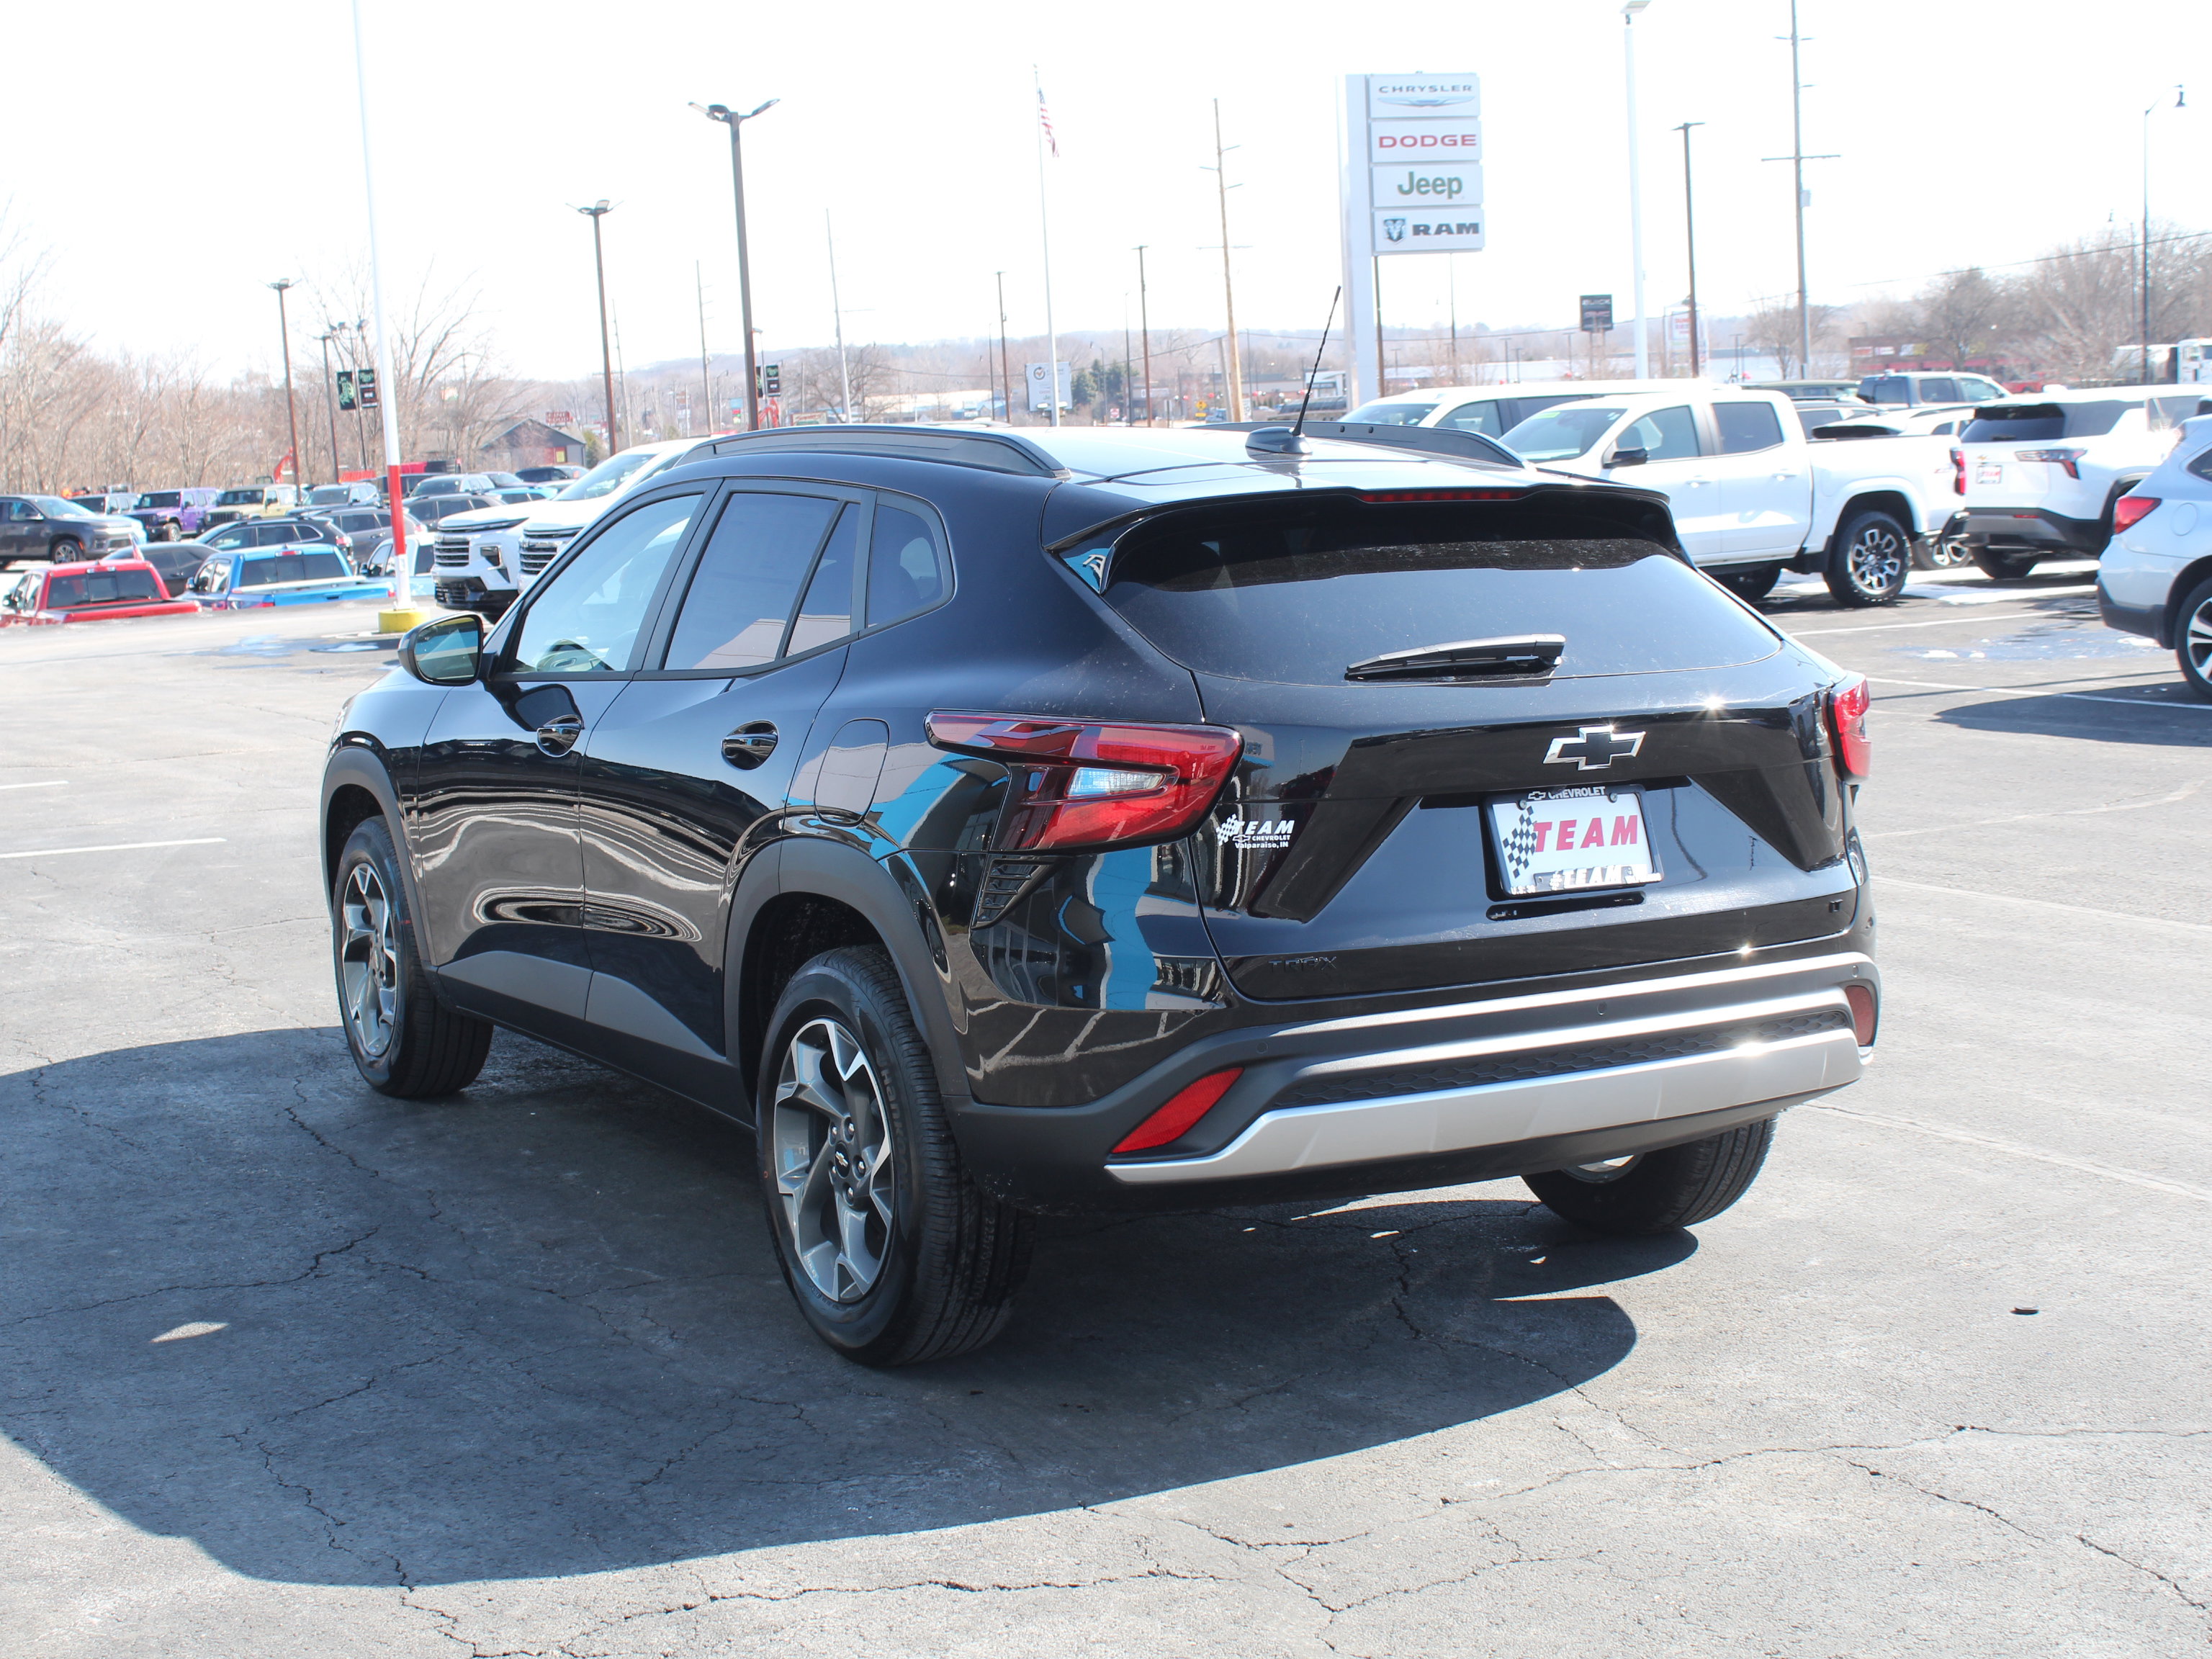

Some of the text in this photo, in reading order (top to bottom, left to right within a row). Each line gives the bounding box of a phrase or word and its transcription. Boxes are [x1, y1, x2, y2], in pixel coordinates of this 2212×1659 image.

[1379, 84, 1473, 93] CHRYSLER
[1379, 135, 1477, 148] DODGE
[1398, 171, 1463, 199] Jeep
[1412, 222, 1480, 236] RAM
[1548, 786, 1606, 800] CHEVROLET
[1232, 820, 1295, 835] TEAM
[1533, 815, 1638, 853] TEAM
